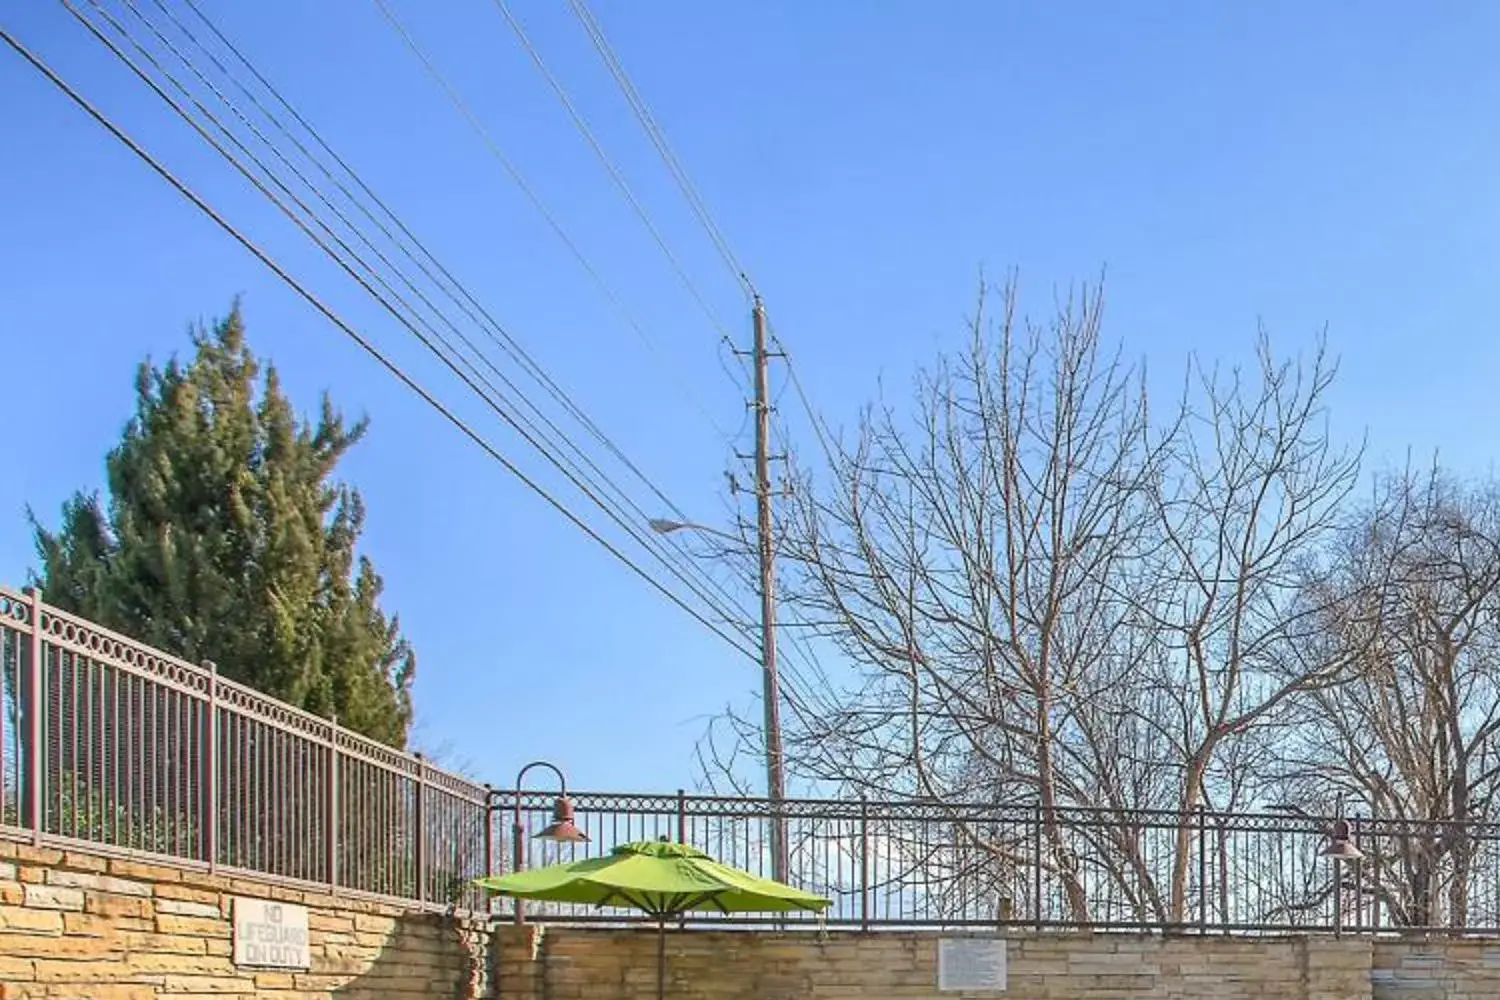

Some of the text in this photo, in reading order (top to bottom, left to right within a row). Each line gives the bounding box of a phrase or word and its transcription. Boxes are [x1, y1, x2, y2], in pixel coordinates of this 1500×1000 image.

[263, 904, 283, 924] NO
[237, 921, 307, 947] LIFEGUARD
[245, 942, 303, 965] ON DUTY
